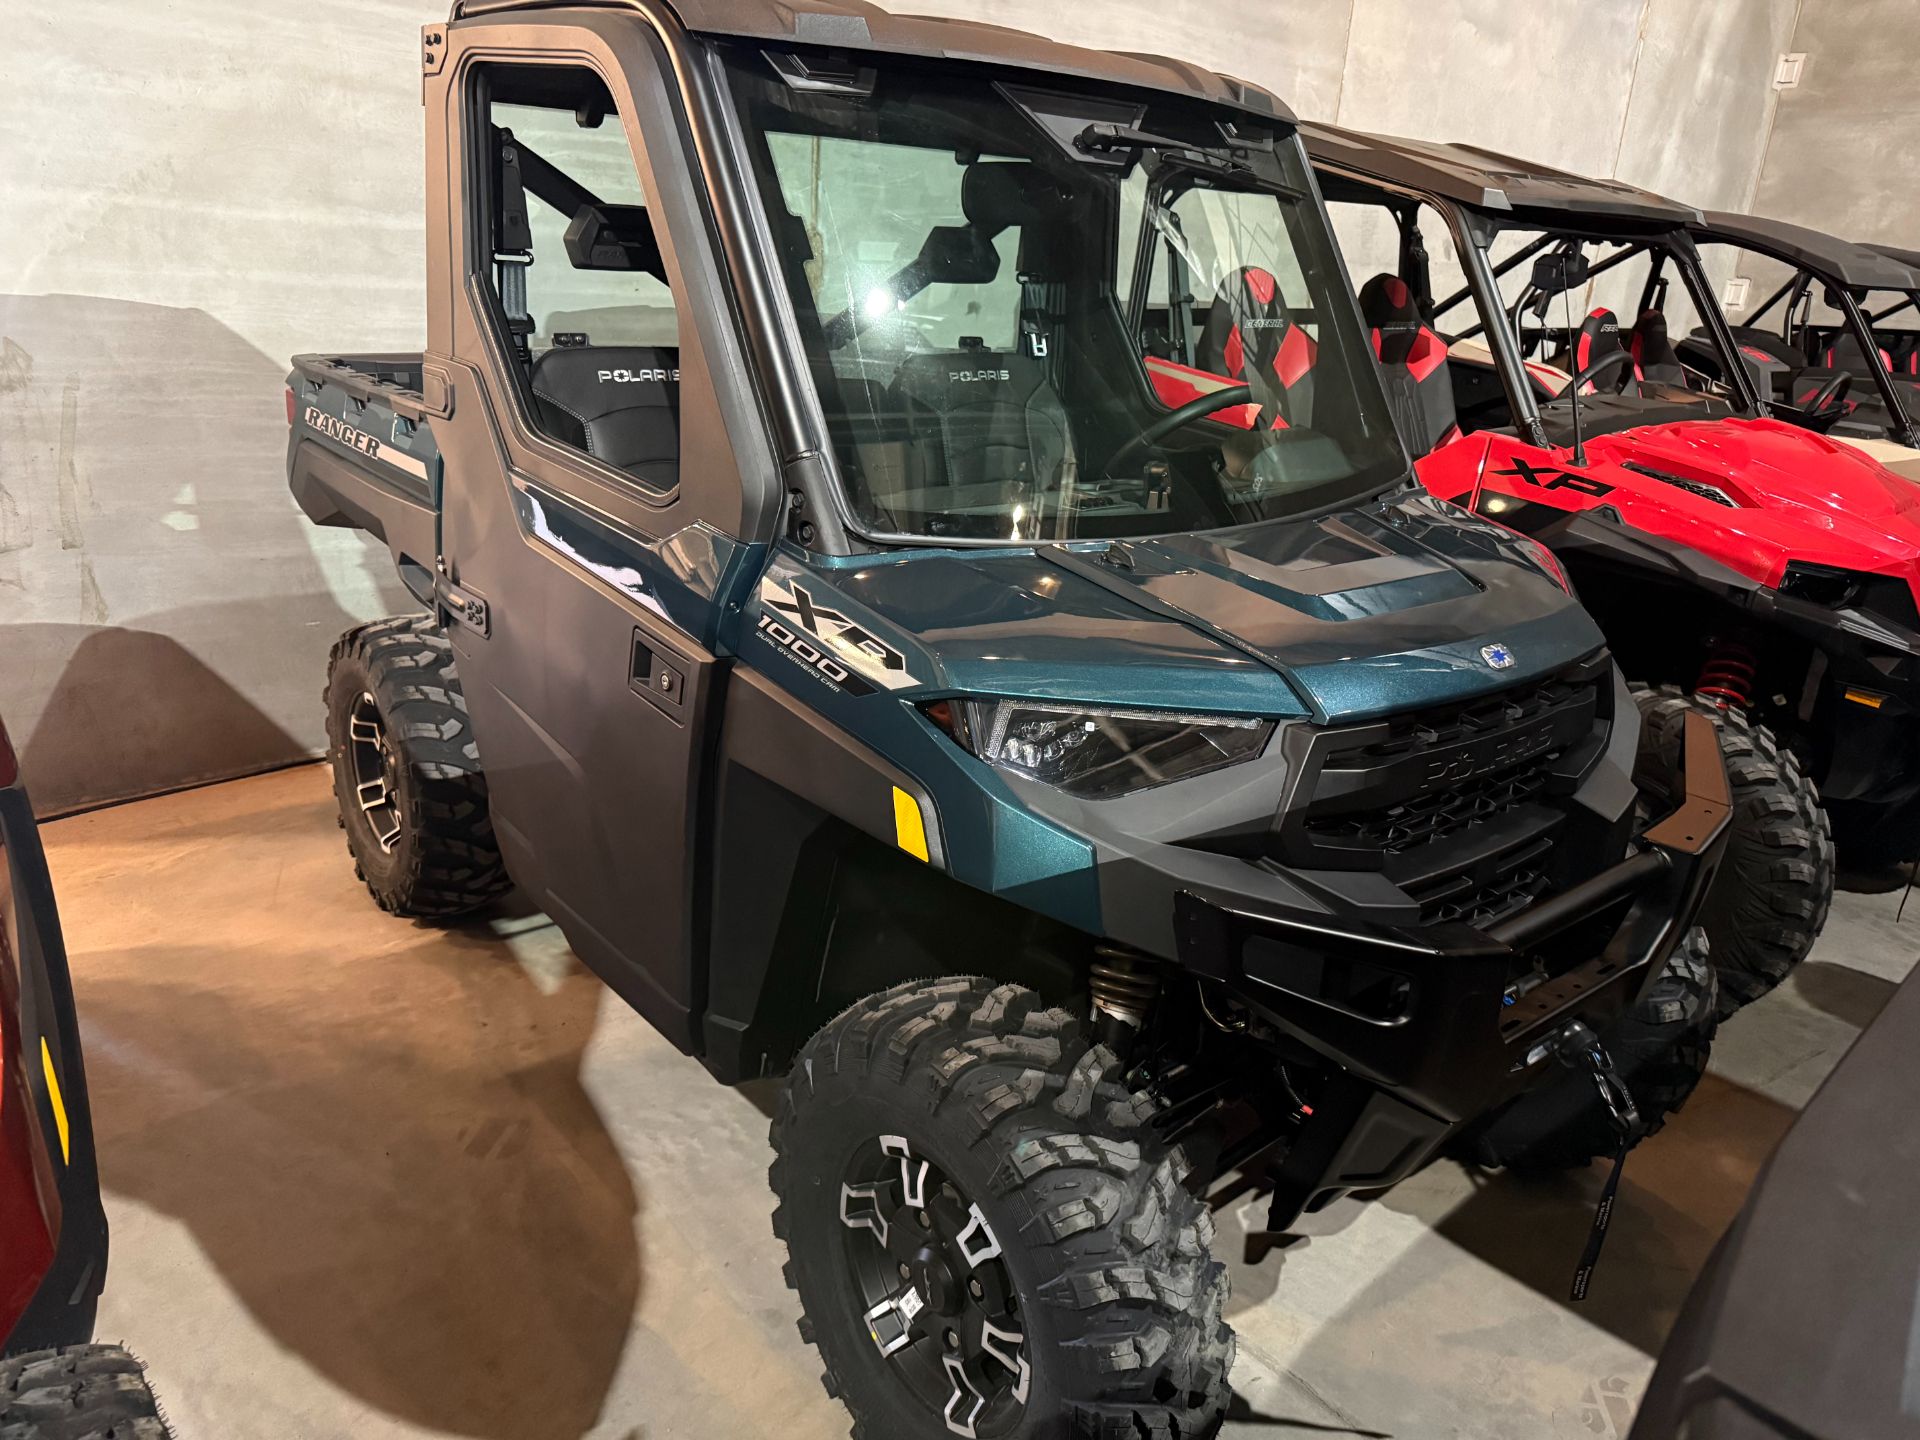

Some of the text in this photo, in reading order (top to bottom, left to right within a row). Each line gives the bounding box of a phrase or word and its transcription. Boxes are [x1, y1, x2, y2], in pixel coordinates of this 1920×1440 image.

[597, 368, 680, 383] POLARIS
[948, 369, 1010, 383] POLARIS
[306, 407, 381, 460] RANGER
[1488, 456, 1617, 498] XP
[757, 614, 849, 682] 1000
[761, 579, 906, 674] XP
[755, 631, 841, 693] DUAL OVERHEAD CAM
[1420, 725, 1553, 789] POLARIS
